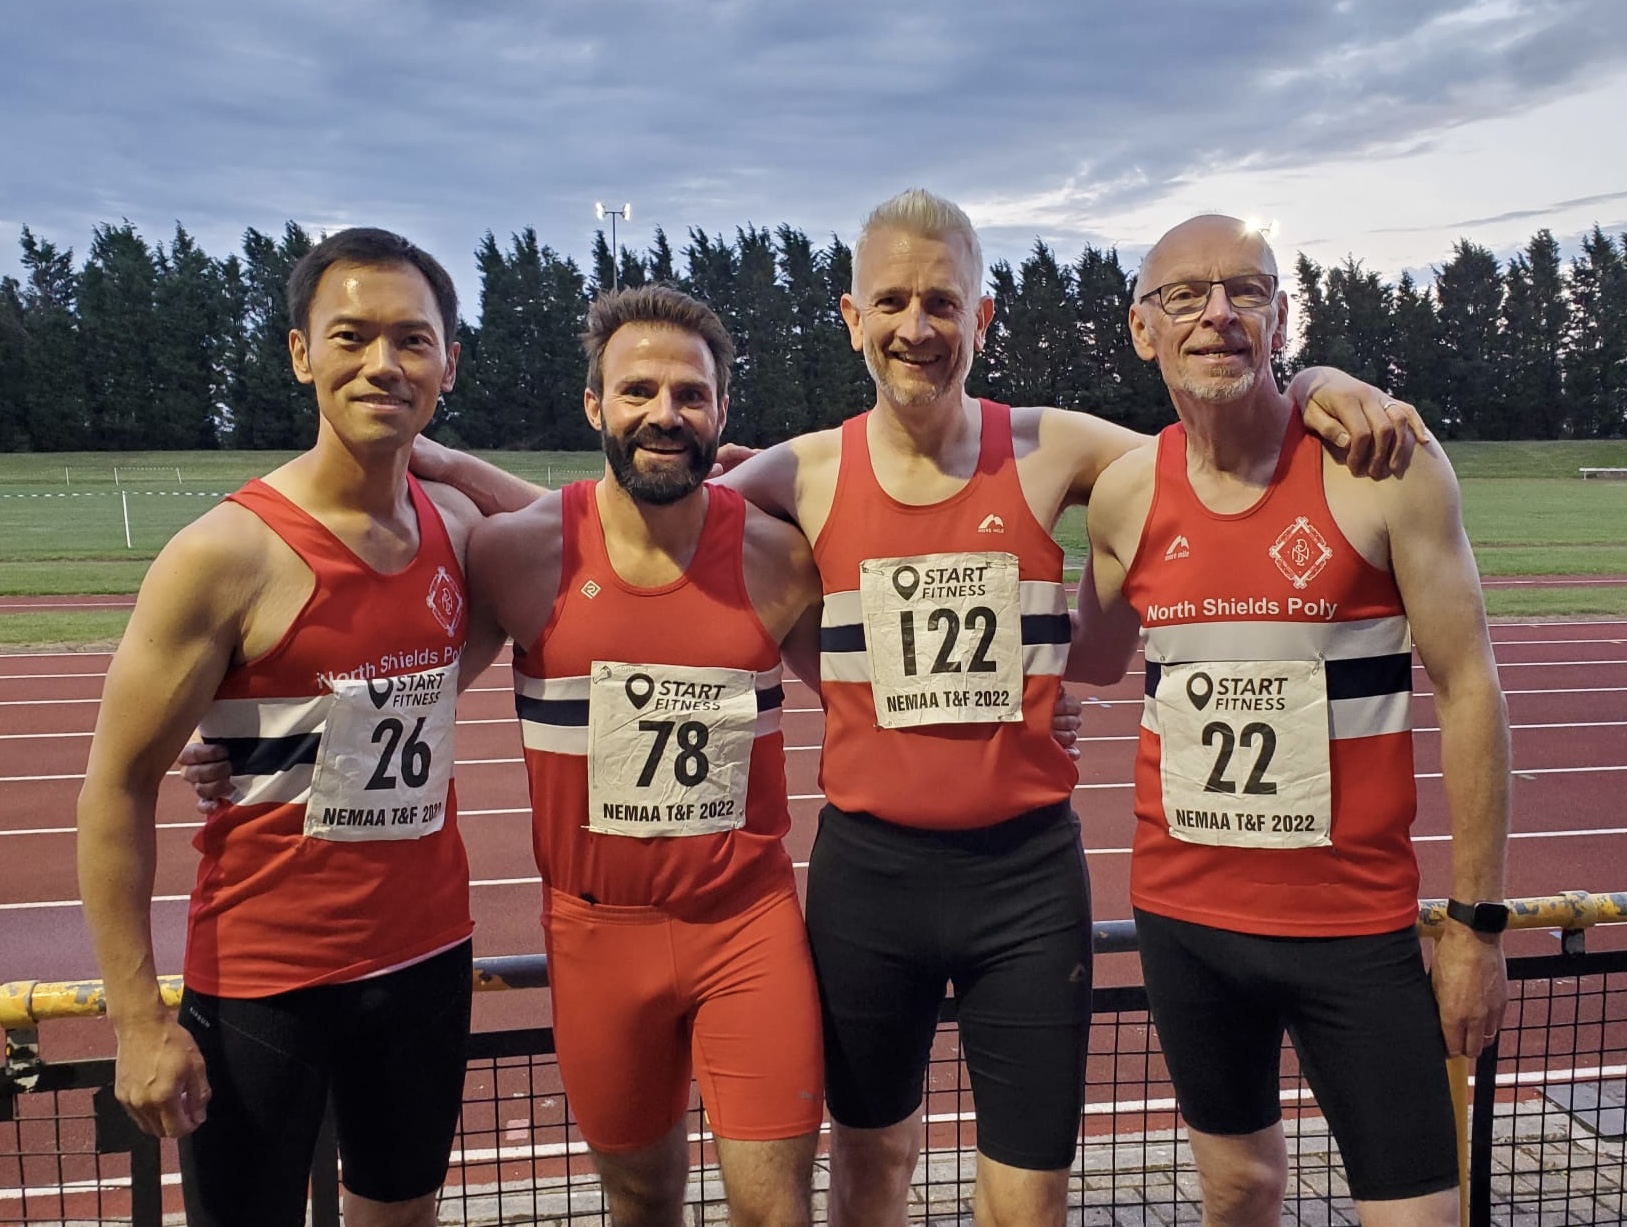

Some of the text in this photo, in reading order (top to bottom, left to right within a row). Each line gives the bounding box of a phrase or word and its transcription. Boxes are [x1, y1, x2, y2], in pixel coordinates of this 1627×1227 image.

[923, 567, 988, 585] START
[922, 584, 986, 599] FITNESS
[1146, 597, 1338, 622] North Shields Poly
[900, 606, 997, 677] 122
[380, 648, 439, 673] Shields
[396, 672, 446, 692] START
[658, 680, 726, 700] START
[1217, 677, 1288, 695] START
[393, 691, 441, 708] FITNESS
[655, 698, 721, 711] FITNESS
[886, 690, 1010, 713] NEMAA T&F 2022
[1215, 697, 1286, 711] FITNESS
[364, 716, 432, 791] 26
[635, 720, 709, 788] 78
[1201, 721, 1277, 795] 22
[322, 807, 386, 827] NEMAA
[391, 806, 418, 825] T&F
[603, 800, 734, 822] NEMAA T&F 2022
[1175, 809, 1315, 832] NEMAA T&F 2022
